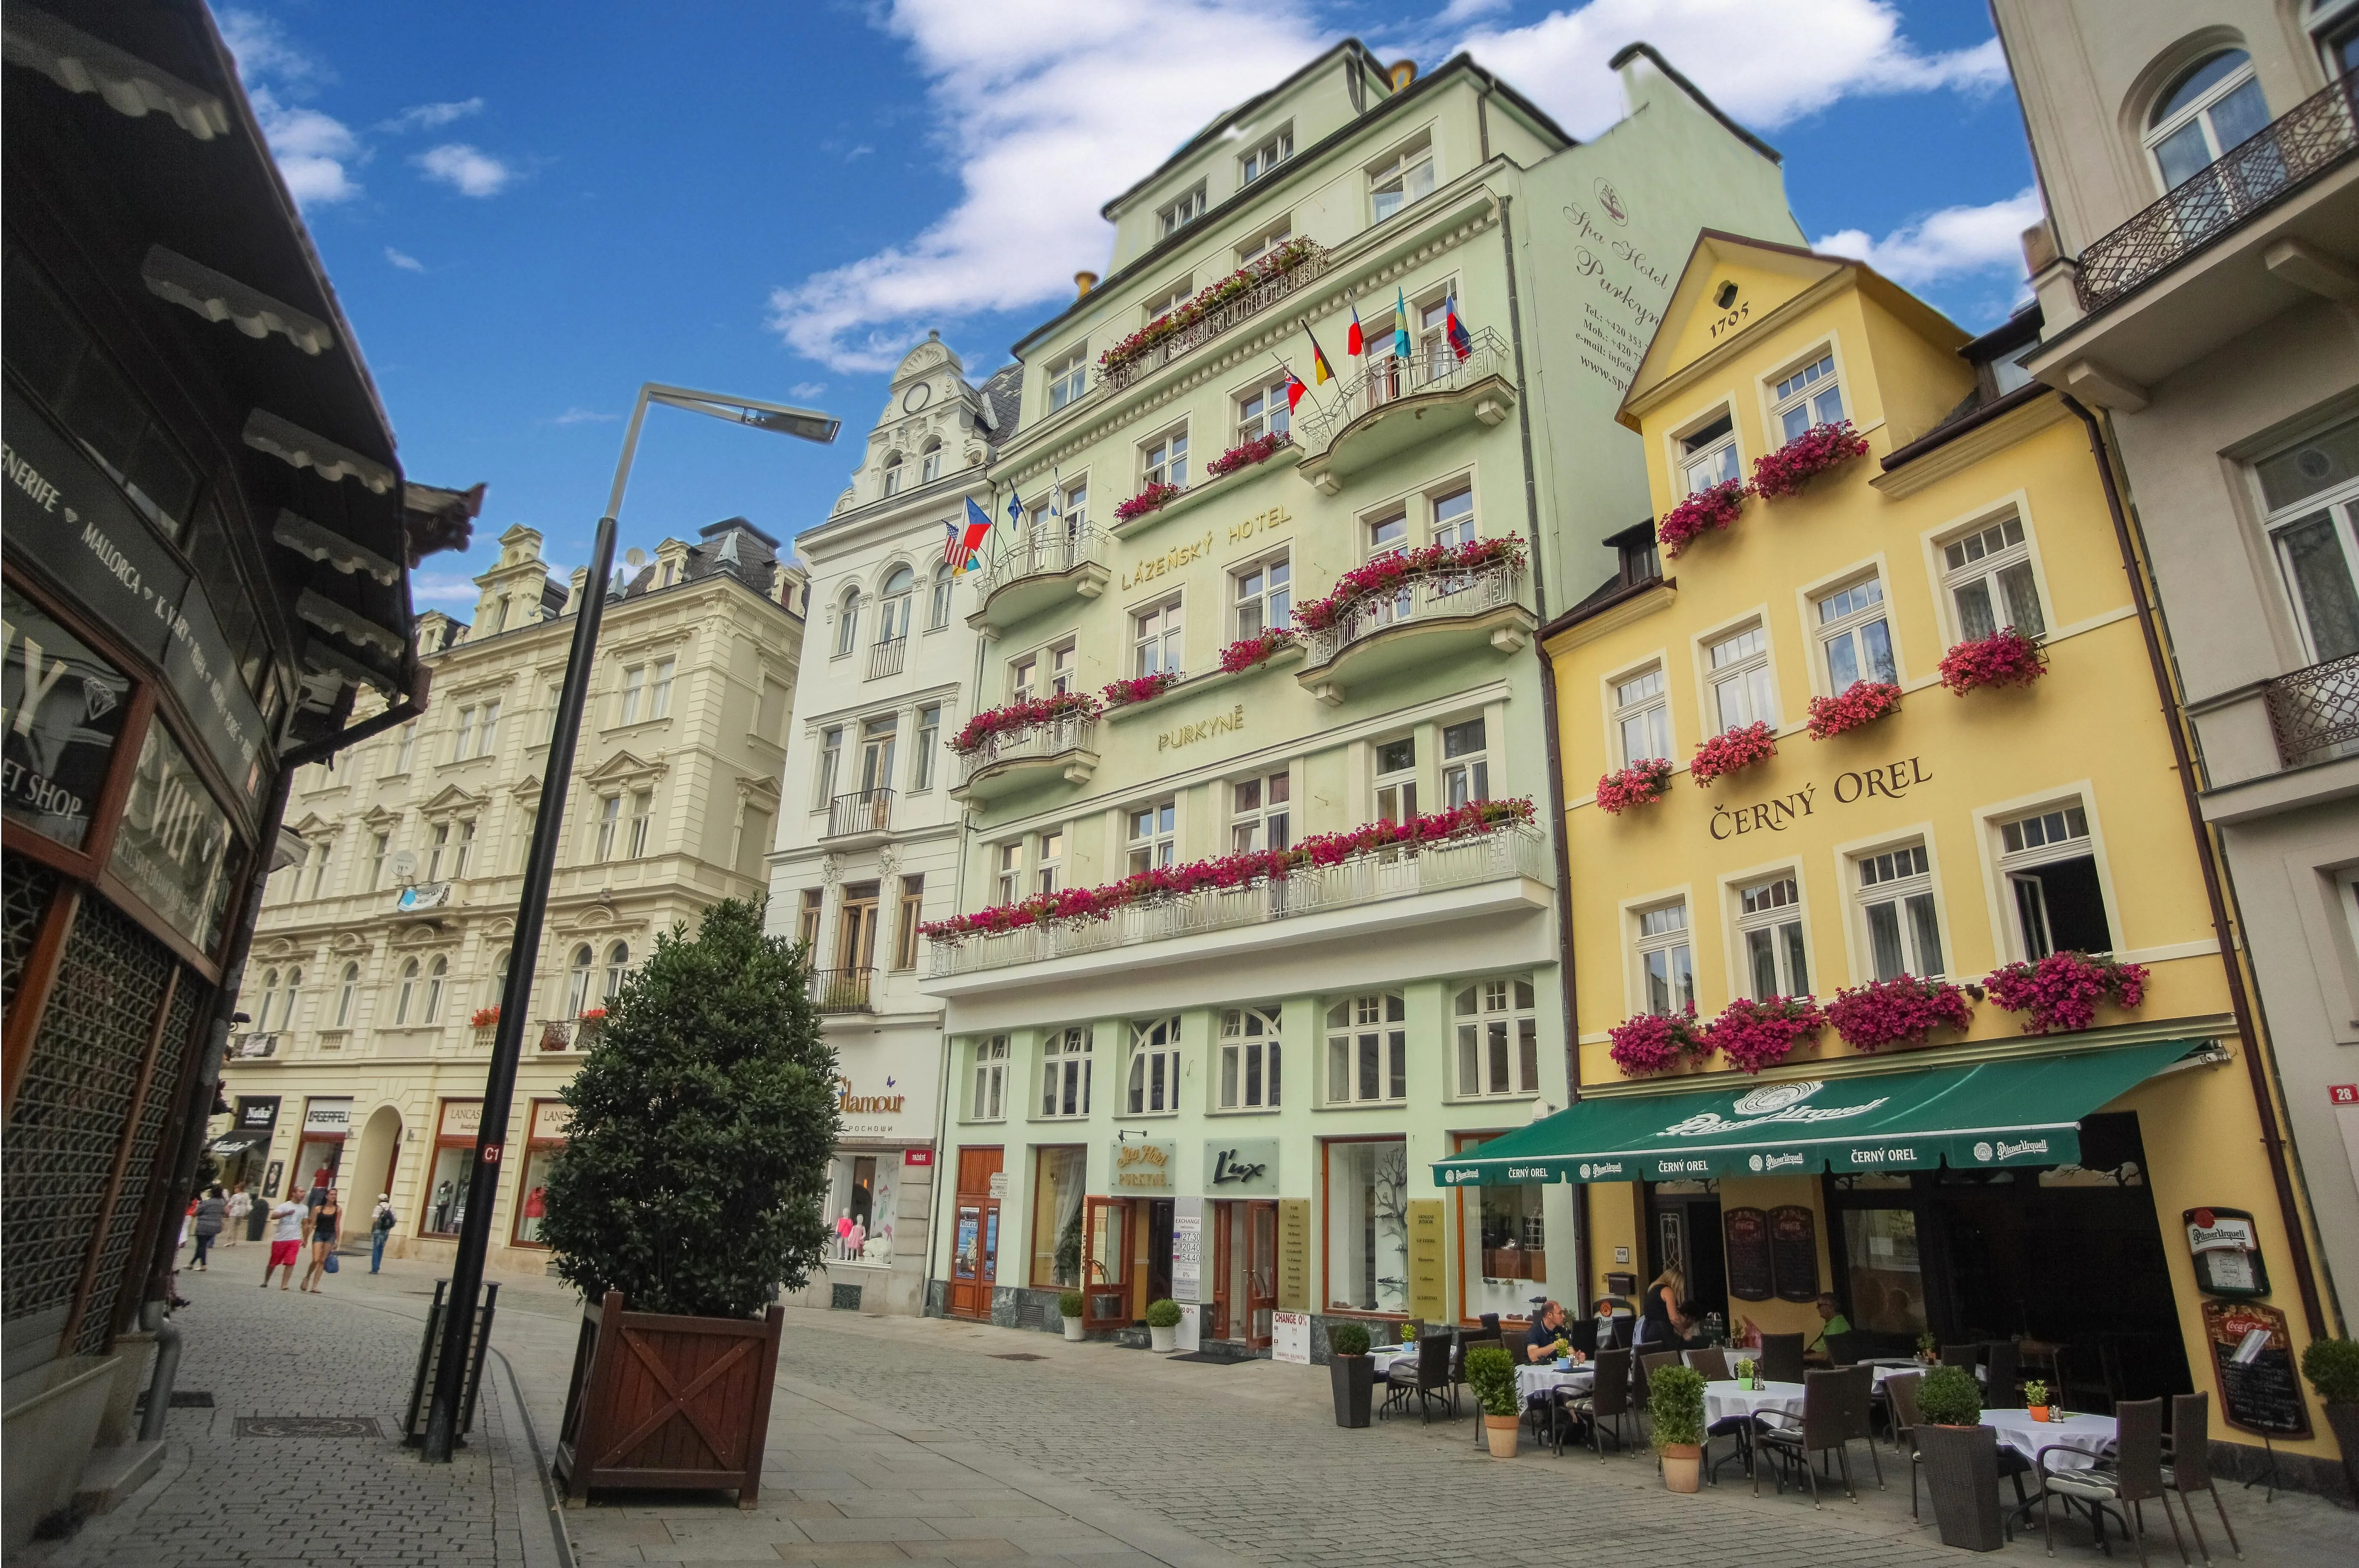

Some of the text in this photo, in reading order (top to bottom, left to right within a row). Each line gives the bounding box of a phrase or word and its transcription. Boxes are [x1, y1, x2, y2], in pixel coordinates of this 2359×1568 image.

[1563, 203, 1667, 289] Spa Hotel
[1584, 302, 1602, 322] Tel.:
[1605, 318, 1626, 338] +420
[1628, 333, 1642, 348] 353
[1709, 301, 1749, 339] 1705
[1576, 332, 1606, 358] e-mail:
[1583, 319, 1608, 342] Mob.:
[1611, 337, 1631, 358] +420
[81, 521, 142, 594] MALLORCA
[1122, 505, 1292, 591] LÁZEŇSKÝ HOTEL
[1158, 704, 1245, 751] PURKYNĚ
[24, 774, 82, 820] SHOP
[1709, 756, 1933, 840] ČERNÝ OREL
[2337, 1088, 2352, 1100] 28
[1656, 1096, 1890, 1137] Pilsner Urquell
[485, 1147, 499, 1161] C1
[912, 1153, 926, 1161] TRŽIŠTĚ
[1117, 1145, 1169, 1168] Spa Hotel
[1850, 1147, 1917, 1163] ČERNÝ OREL
[1997, 1139, 2047, 1160] Pilsner Urquell
[1593, 1162, 1622, 1178] Pilsner Urquell
[1658, 1158, 1709, 1172] ČERNÝ OREL
[1766, 1153, 1804, 1170] Pilsner Urquell
[1119, 1170, 1166, 1186] PURKYNĚ
[1456, 1169, 1479, 1182] Pilsner Urquell
[1508, 1166, 1548, 1177] ČERNÝ OREL
[960, 1219, 978, 1228] Morava
[2193, 1228, 2247, 1245] Pilsner Urquell
[1275, 1313, 1307, 1326] CHANGE 0%
